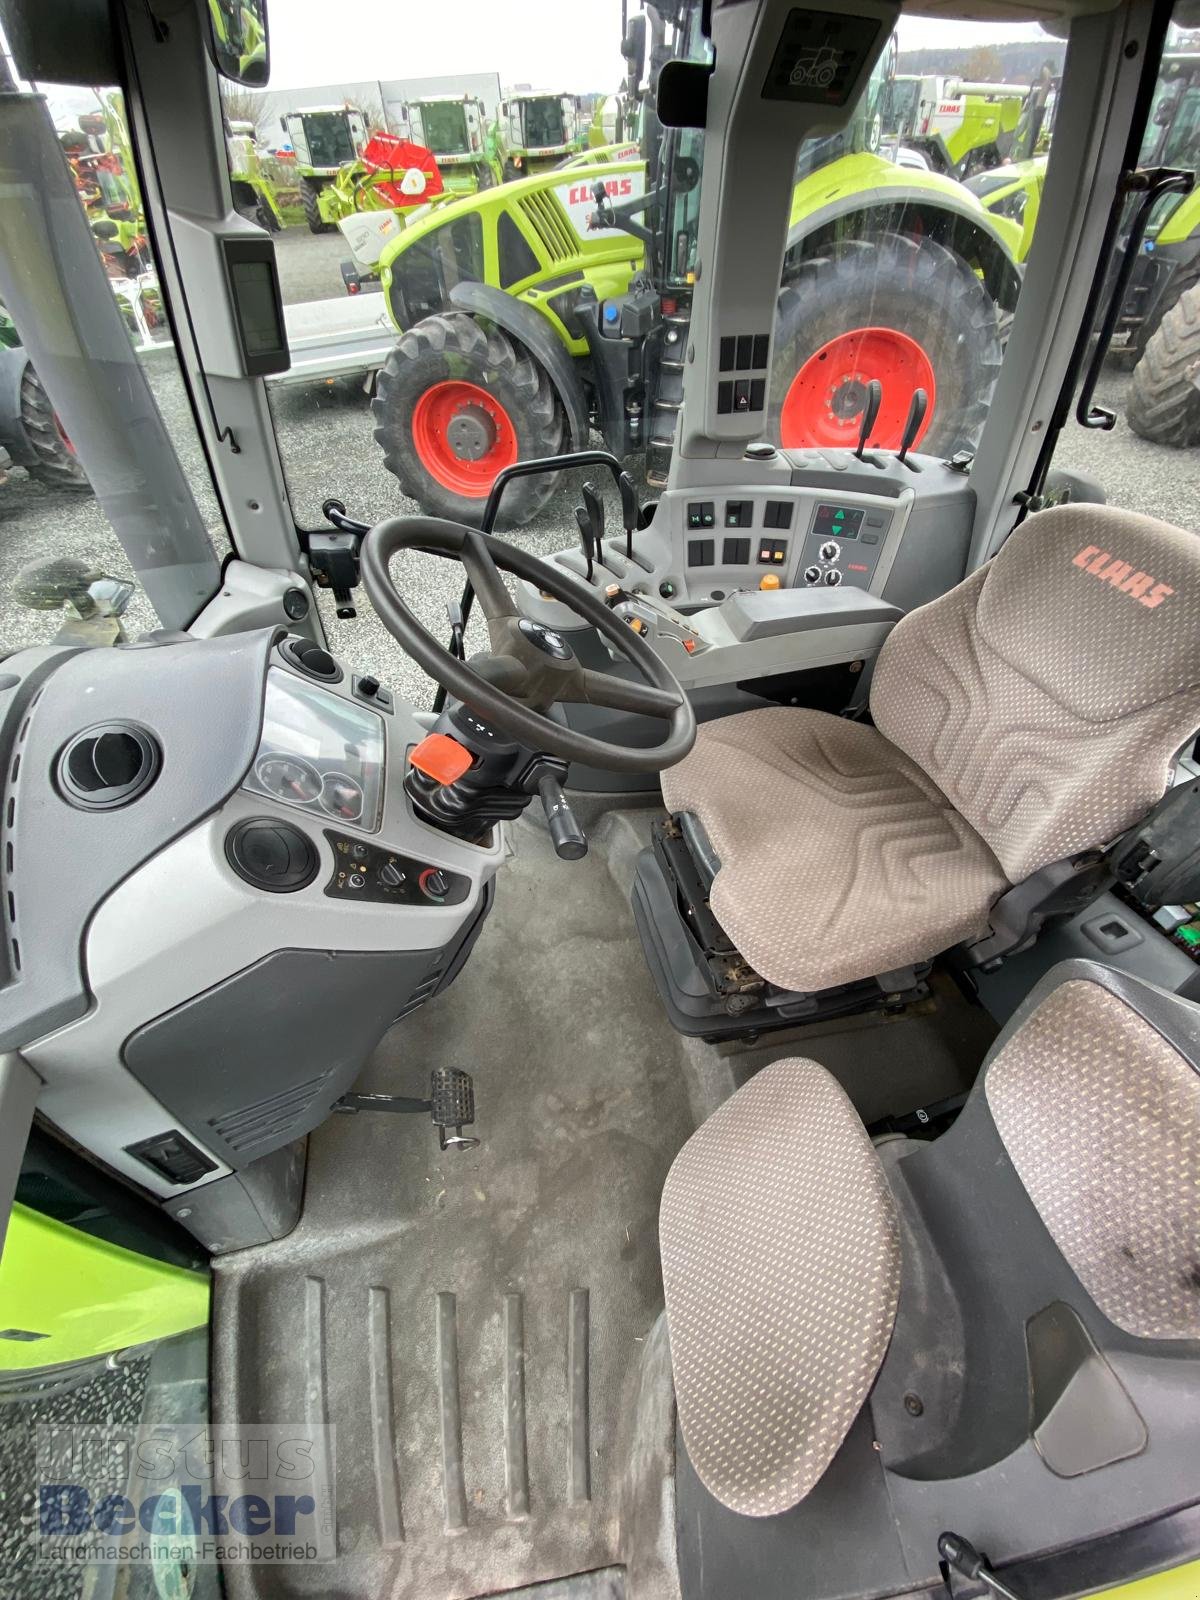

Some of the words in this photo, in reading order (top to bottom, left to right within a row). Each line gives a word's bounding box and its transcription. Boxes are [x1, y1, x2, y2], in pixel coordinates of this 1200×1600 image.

[938, 104, 961, 113] CLAAS
[569, 179, 632, 205] CLAS
[1072, 545, 1175, 609] CLAAS
